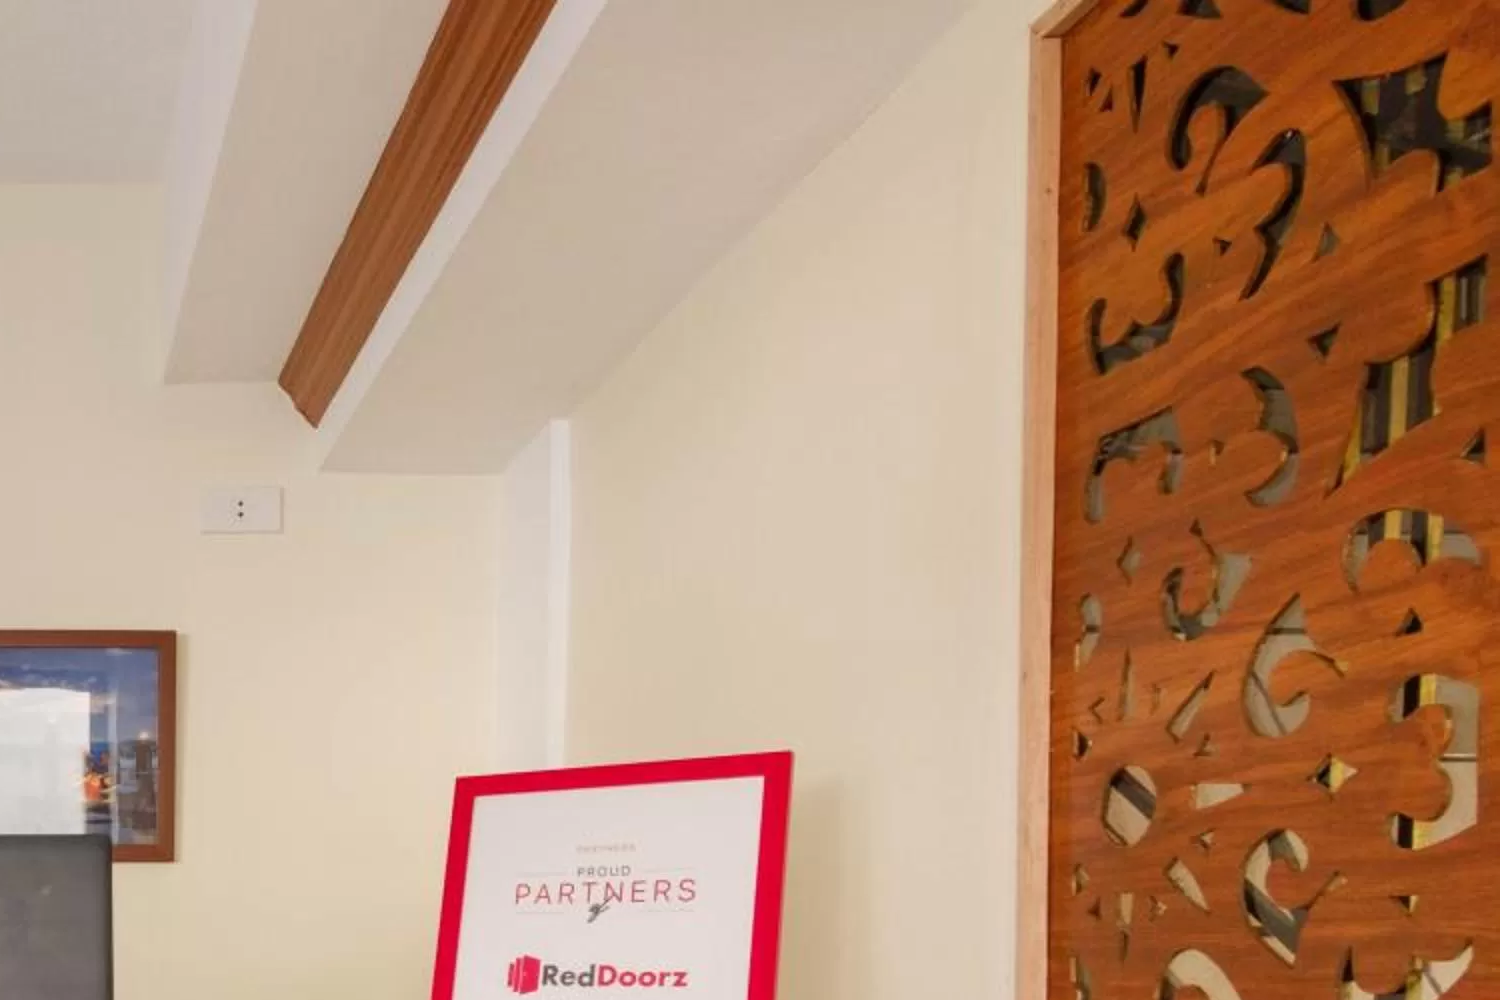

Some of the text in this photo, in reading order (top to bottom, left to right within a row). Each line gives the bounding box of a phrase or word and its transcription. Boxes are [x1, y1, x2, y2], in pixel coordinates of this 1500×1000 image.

[577, 865, 633, 878] PROUD
[514, 877, 697, 905] PARTNERS
[541, 963, 689, 988] RedDoorz
